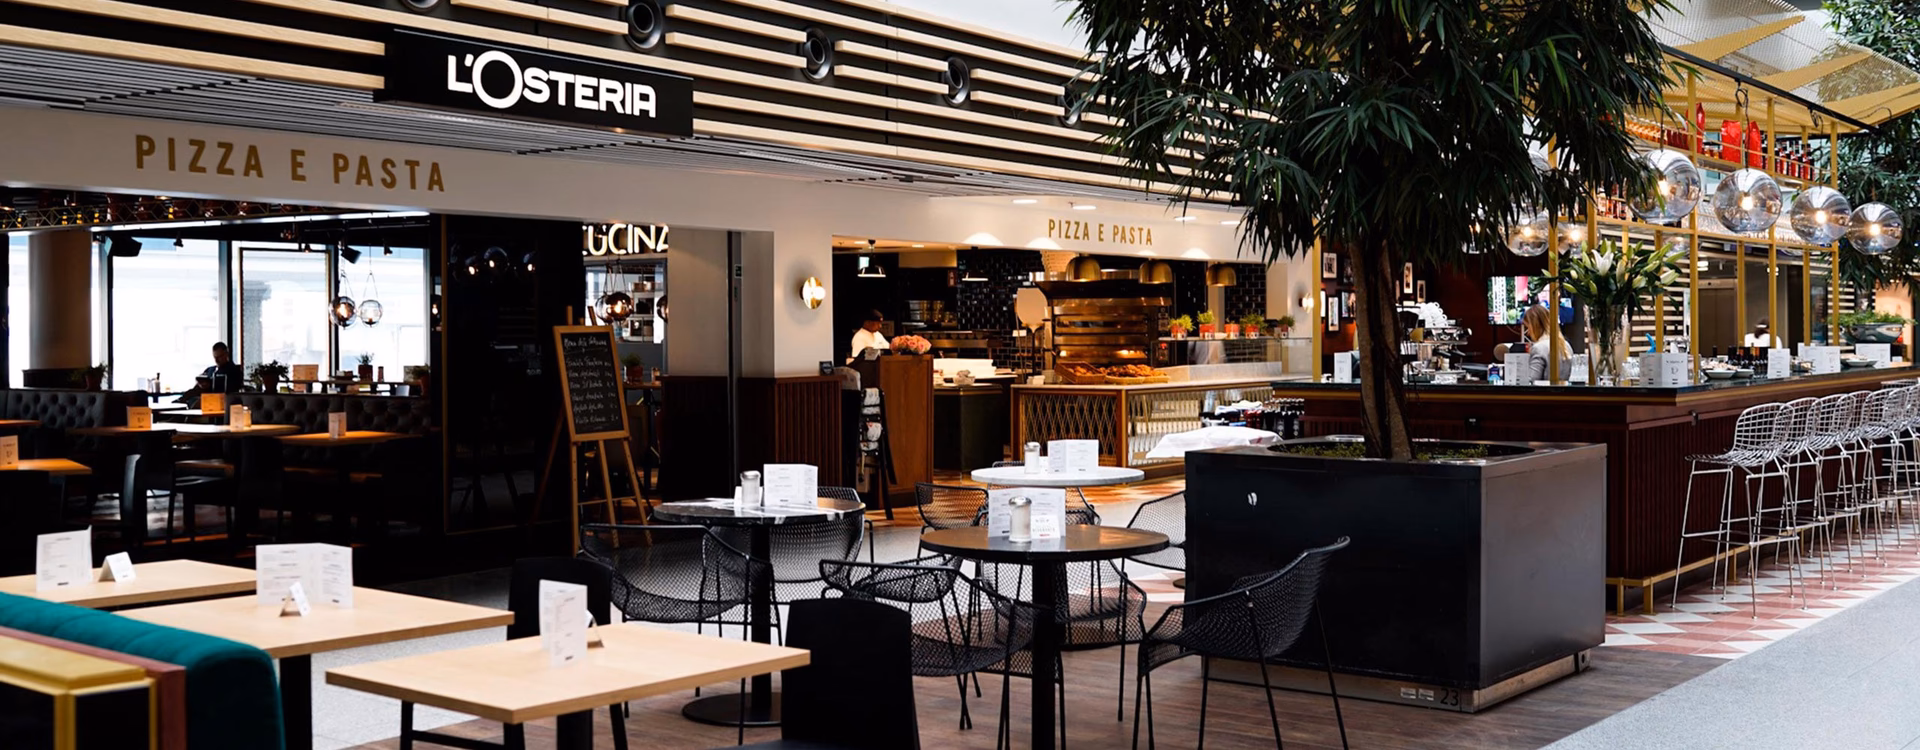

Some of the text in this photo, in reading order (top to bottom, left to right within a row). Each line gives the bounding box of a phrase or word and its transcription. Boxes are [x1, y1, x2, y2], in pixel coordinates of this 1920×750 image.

[135, 134, 445, 193] PIZZA E PASTA
[582, 223, 670, 256] UCINA
[1048, 218, 1153, 246] PIZZA E PASTA
[1440, 688, 1459, 706] 23
